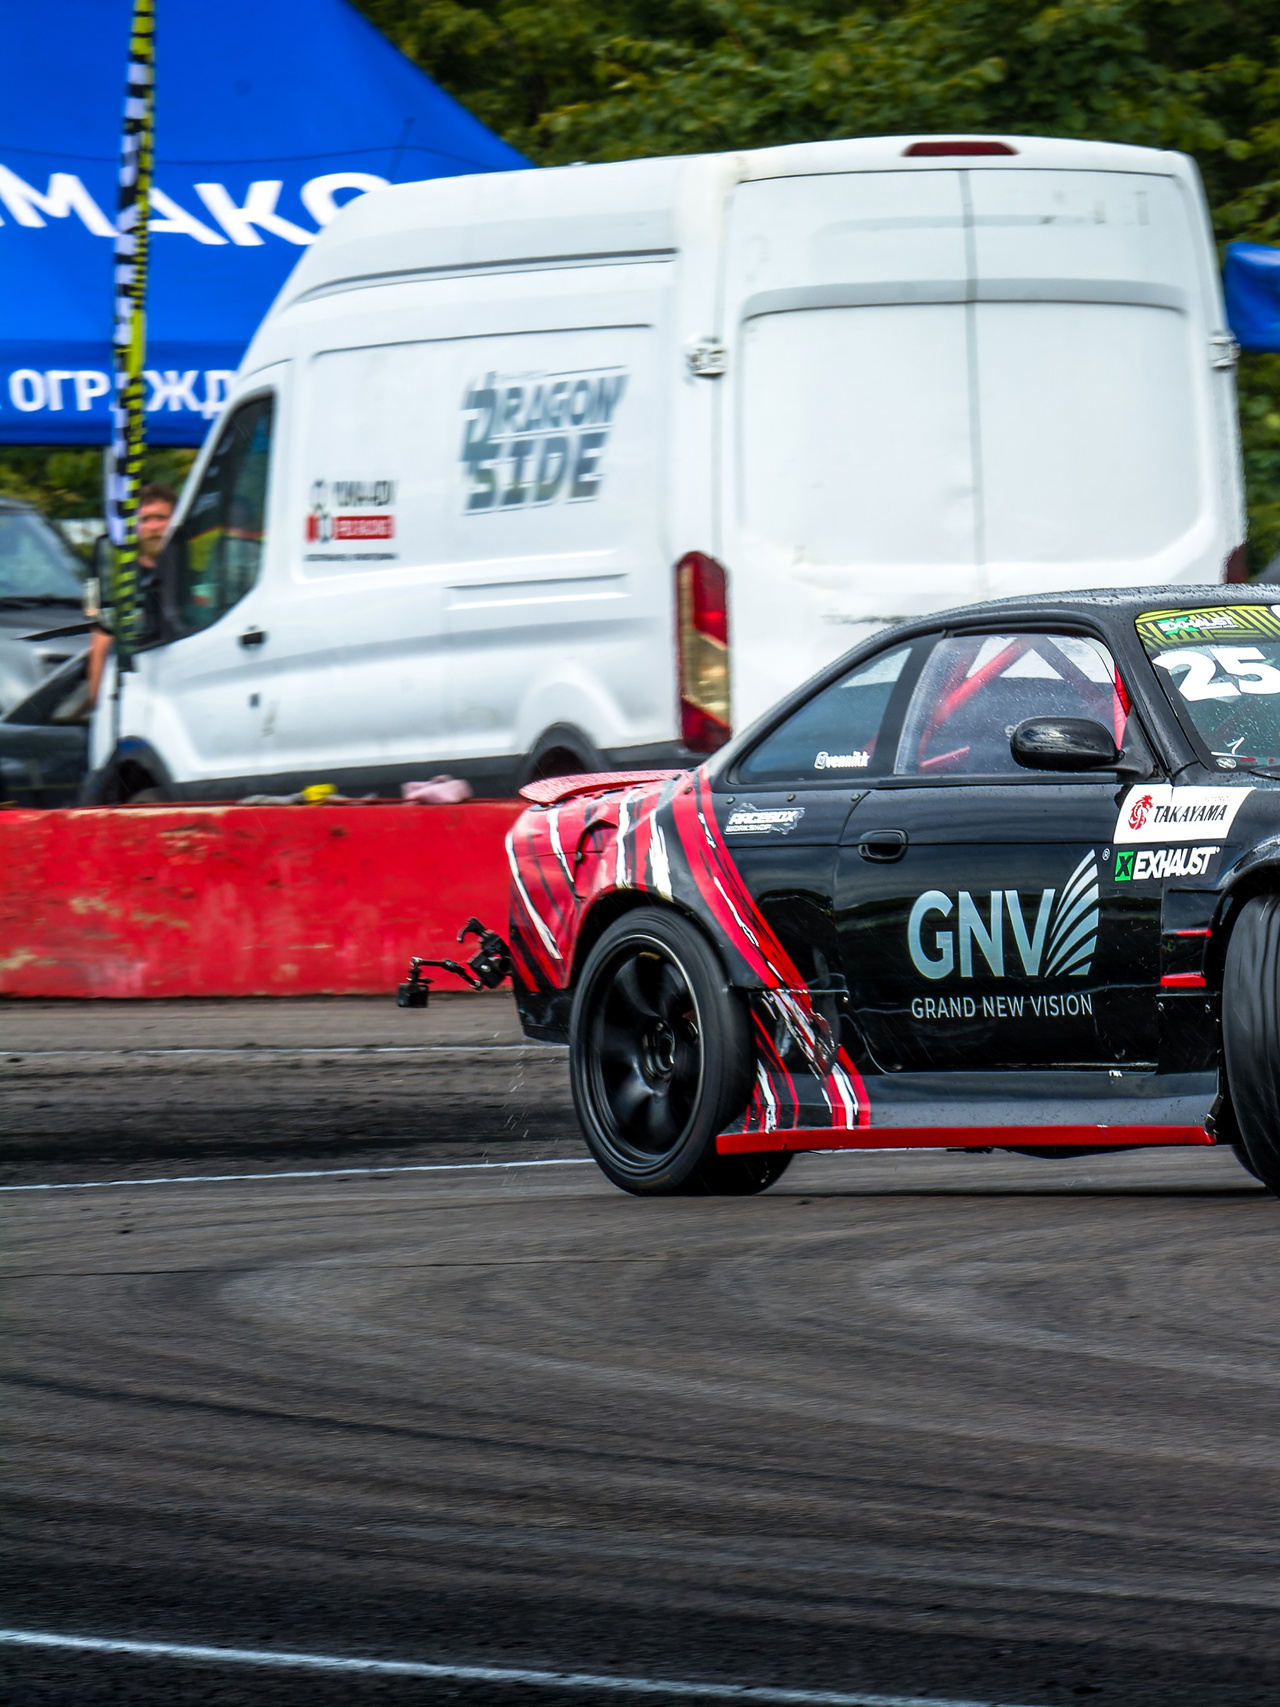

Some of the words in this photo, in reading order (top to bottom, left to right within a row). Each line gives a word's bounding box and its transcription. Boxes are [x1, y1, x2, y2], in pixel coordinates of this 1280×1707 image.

[8, 369, 238, 420] ОГРЖД
[463, 431, 611, 515] SIDE
[1153, 804, 1228, 823] TAKAYAMA
[1133, 846, 1218, 880] EXHAUST
[907, 888, 1056, 980] GNV
[911, 997, 976, 1019] GRAND
[982, 995, 1024, 1017] NEW
[1030, 994, 1093, 1016] VISION
